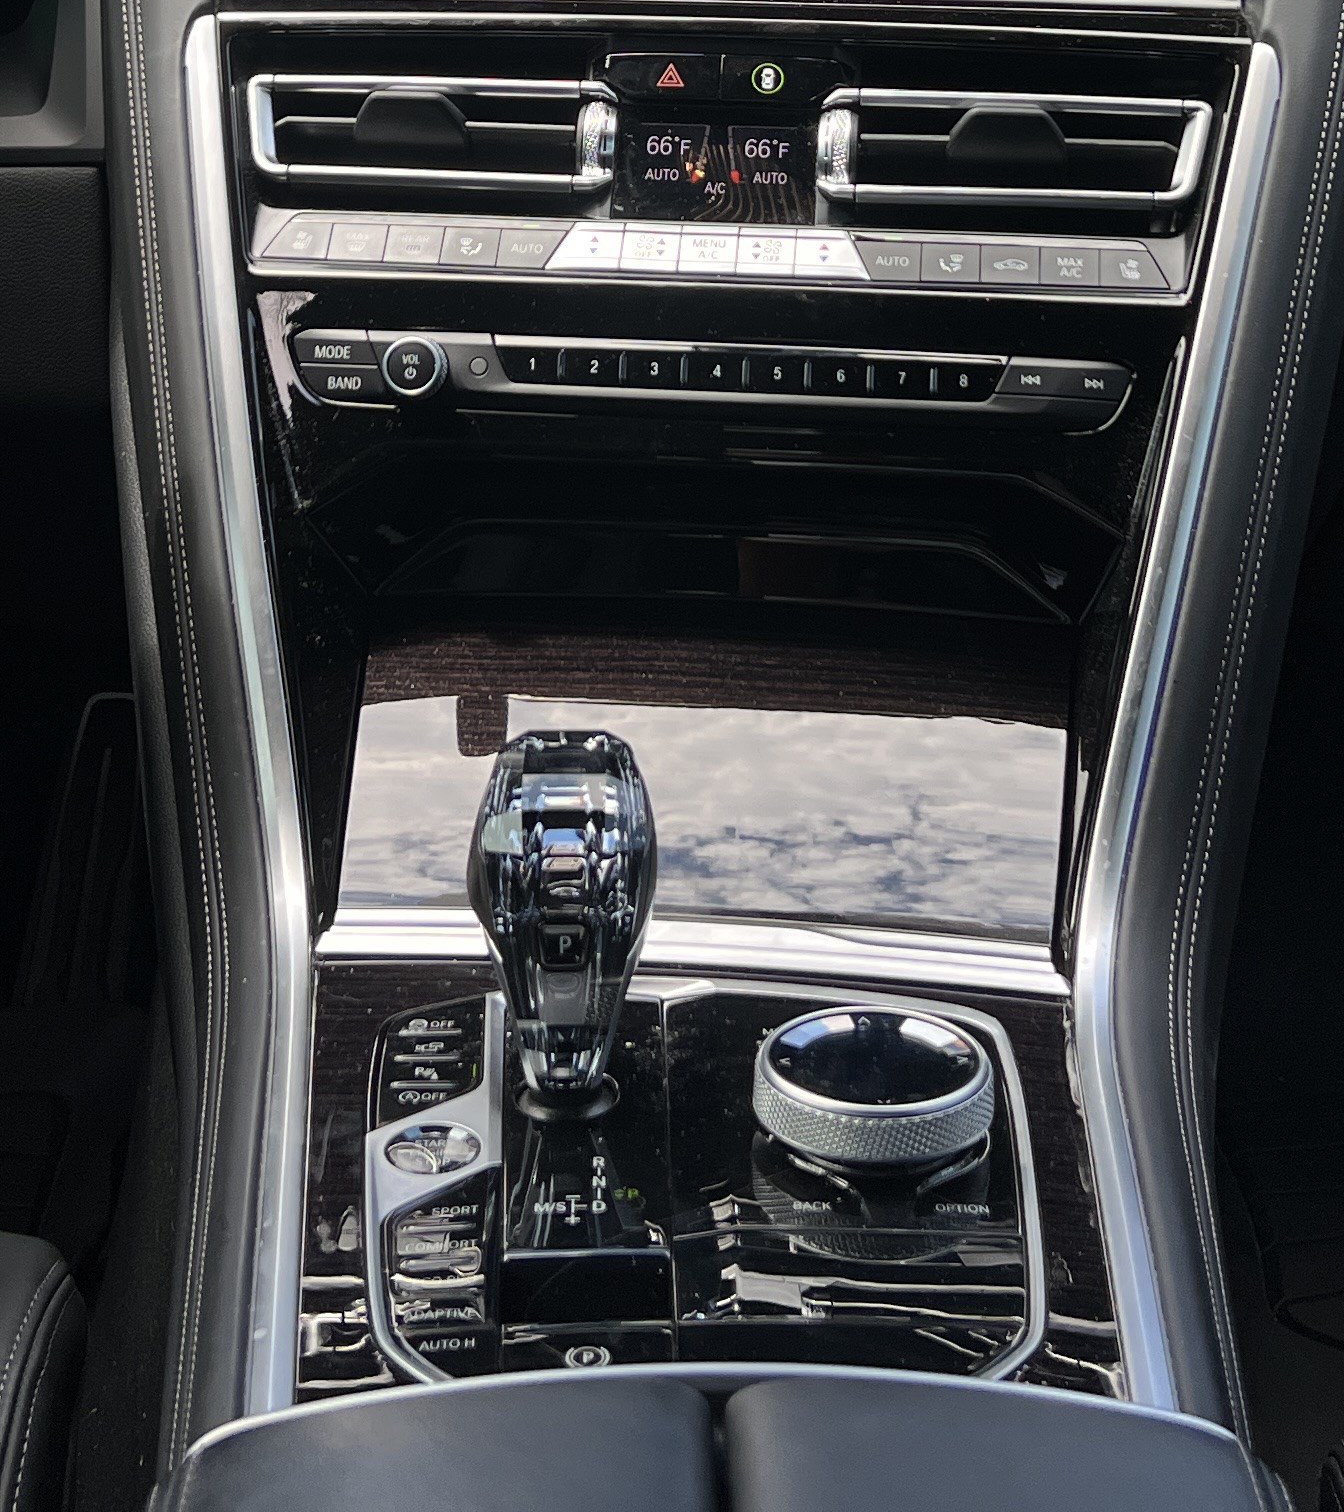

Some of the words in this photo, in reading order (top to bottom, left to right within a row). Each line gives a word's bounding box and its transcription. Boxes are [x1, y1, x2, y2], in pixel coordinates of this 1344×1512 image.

[646, 135, 692, 156] 66°F
[744, 138, 790, 159] 66°F
[644, 168, 680, 182] AUTO
[753, 171, 787, 185] AUTO
[704, 182, 726, 196] A/C
[510, 242, 544, 256] AUTO
[692, 238, 727, 249] MENU
[875, 254, 910, 268] AUTO
[1056, 255, 1085, 268] MAX
[1059, 266, 1083, 279] A/C
[314, 344, 351, 360] MODE
[401, 353, 421, 365] VOL
[528, 357, 536, 371] 1
[590, 360, 599, 374] 2
[650, 362, 659, 376] 3
[711, 364, 722, 378] 4
[773, 366, 783, 381] 5
[836, 369, 846, 383] 6
[898, 371, 907, 385] 7
[959, 374, 968, 388] 8
[327, 375, 362, 390] BAND
[559, 935, 572, 955] P
[430, 1020, 455, 1029] OFF
[592, 1156, 605, 1169] R
[592, 1175, 606, 1189] N
[432, 1204, 479, 1217] SPORT
[592, 1200, 607, 1215] D
[793, 1201, 832, 1211] BACK
[934, 1203, 991, 1216] OPTION
[419, 1339, 460, 1352] AUTO
[465, 1337, 475, 1349] H
